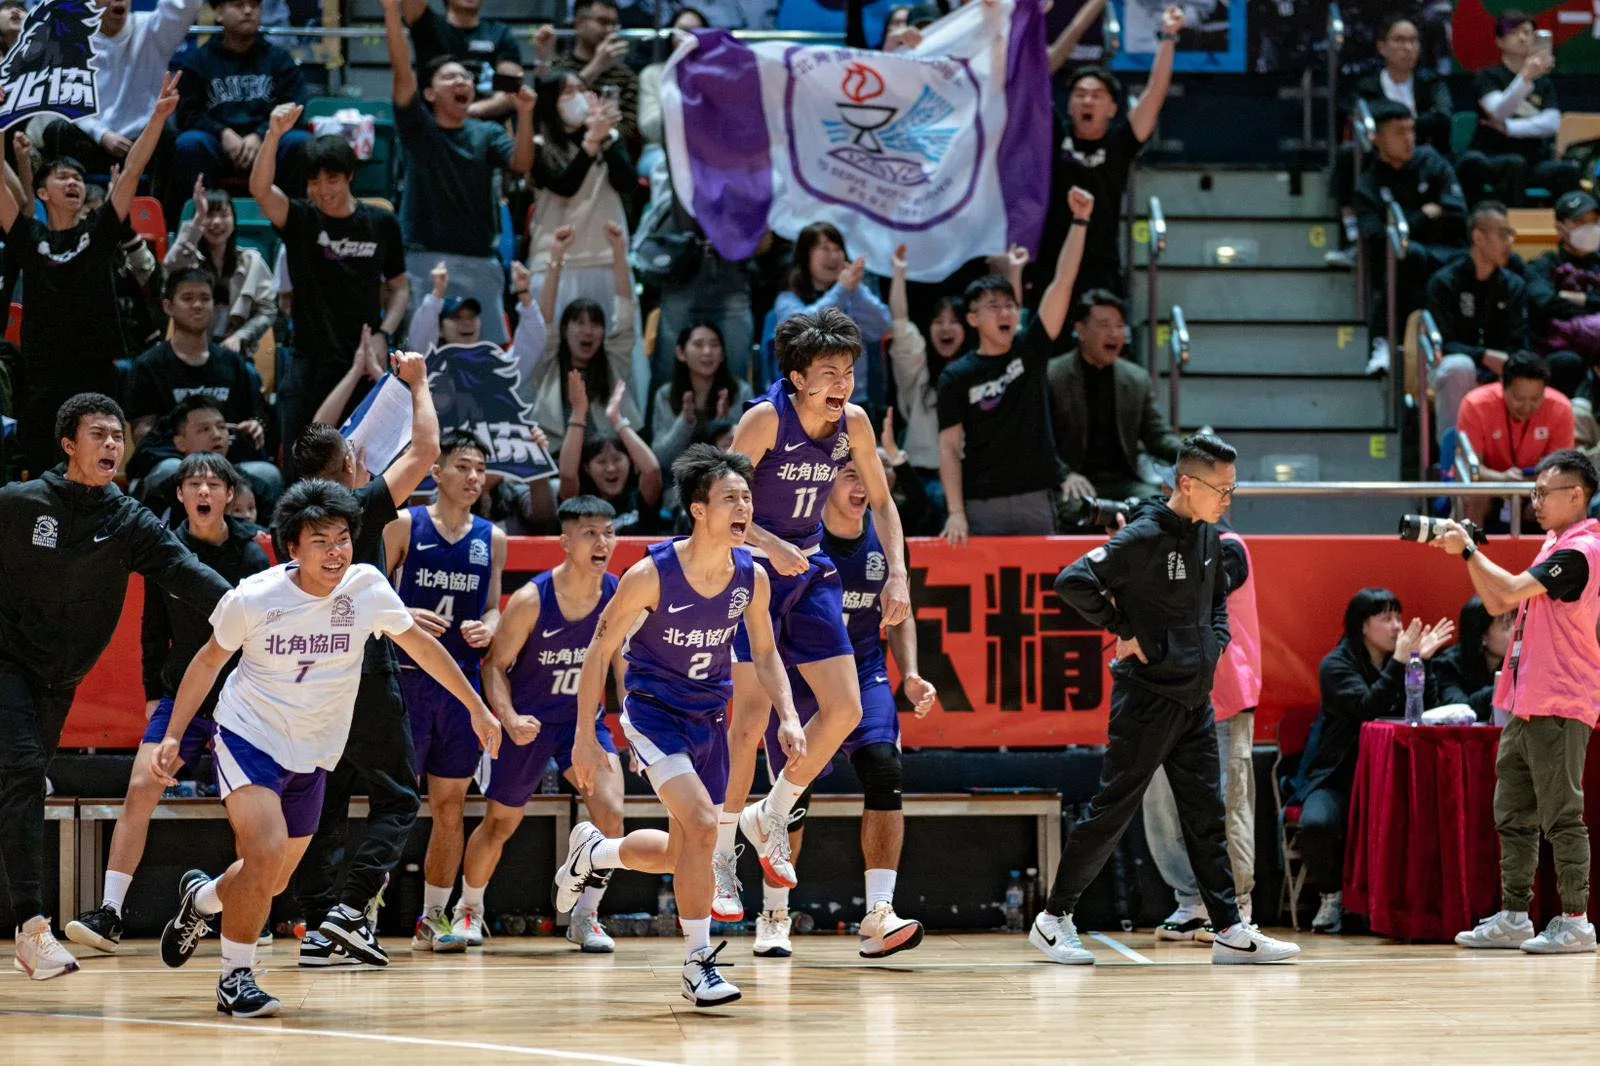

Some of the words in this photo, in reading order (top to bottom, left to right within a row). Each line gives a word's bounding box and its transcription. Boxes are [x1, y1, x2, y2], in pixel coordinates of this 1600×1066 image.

[0, 66, 94, 117] 北協
[1336, 326, 1355, 349] F
[1369, 435, 1387, 457] E
[792, 487, 818, 518] 11
[415, 567, 480, 592] 北角協同
[435, 595, 455, 622] 4
[264, 633, 350, 655] 北角協同
[295, 660, 315, 683] 7
[687, 652, 712, 680] 2
[551, 668, 581, 695] 10
